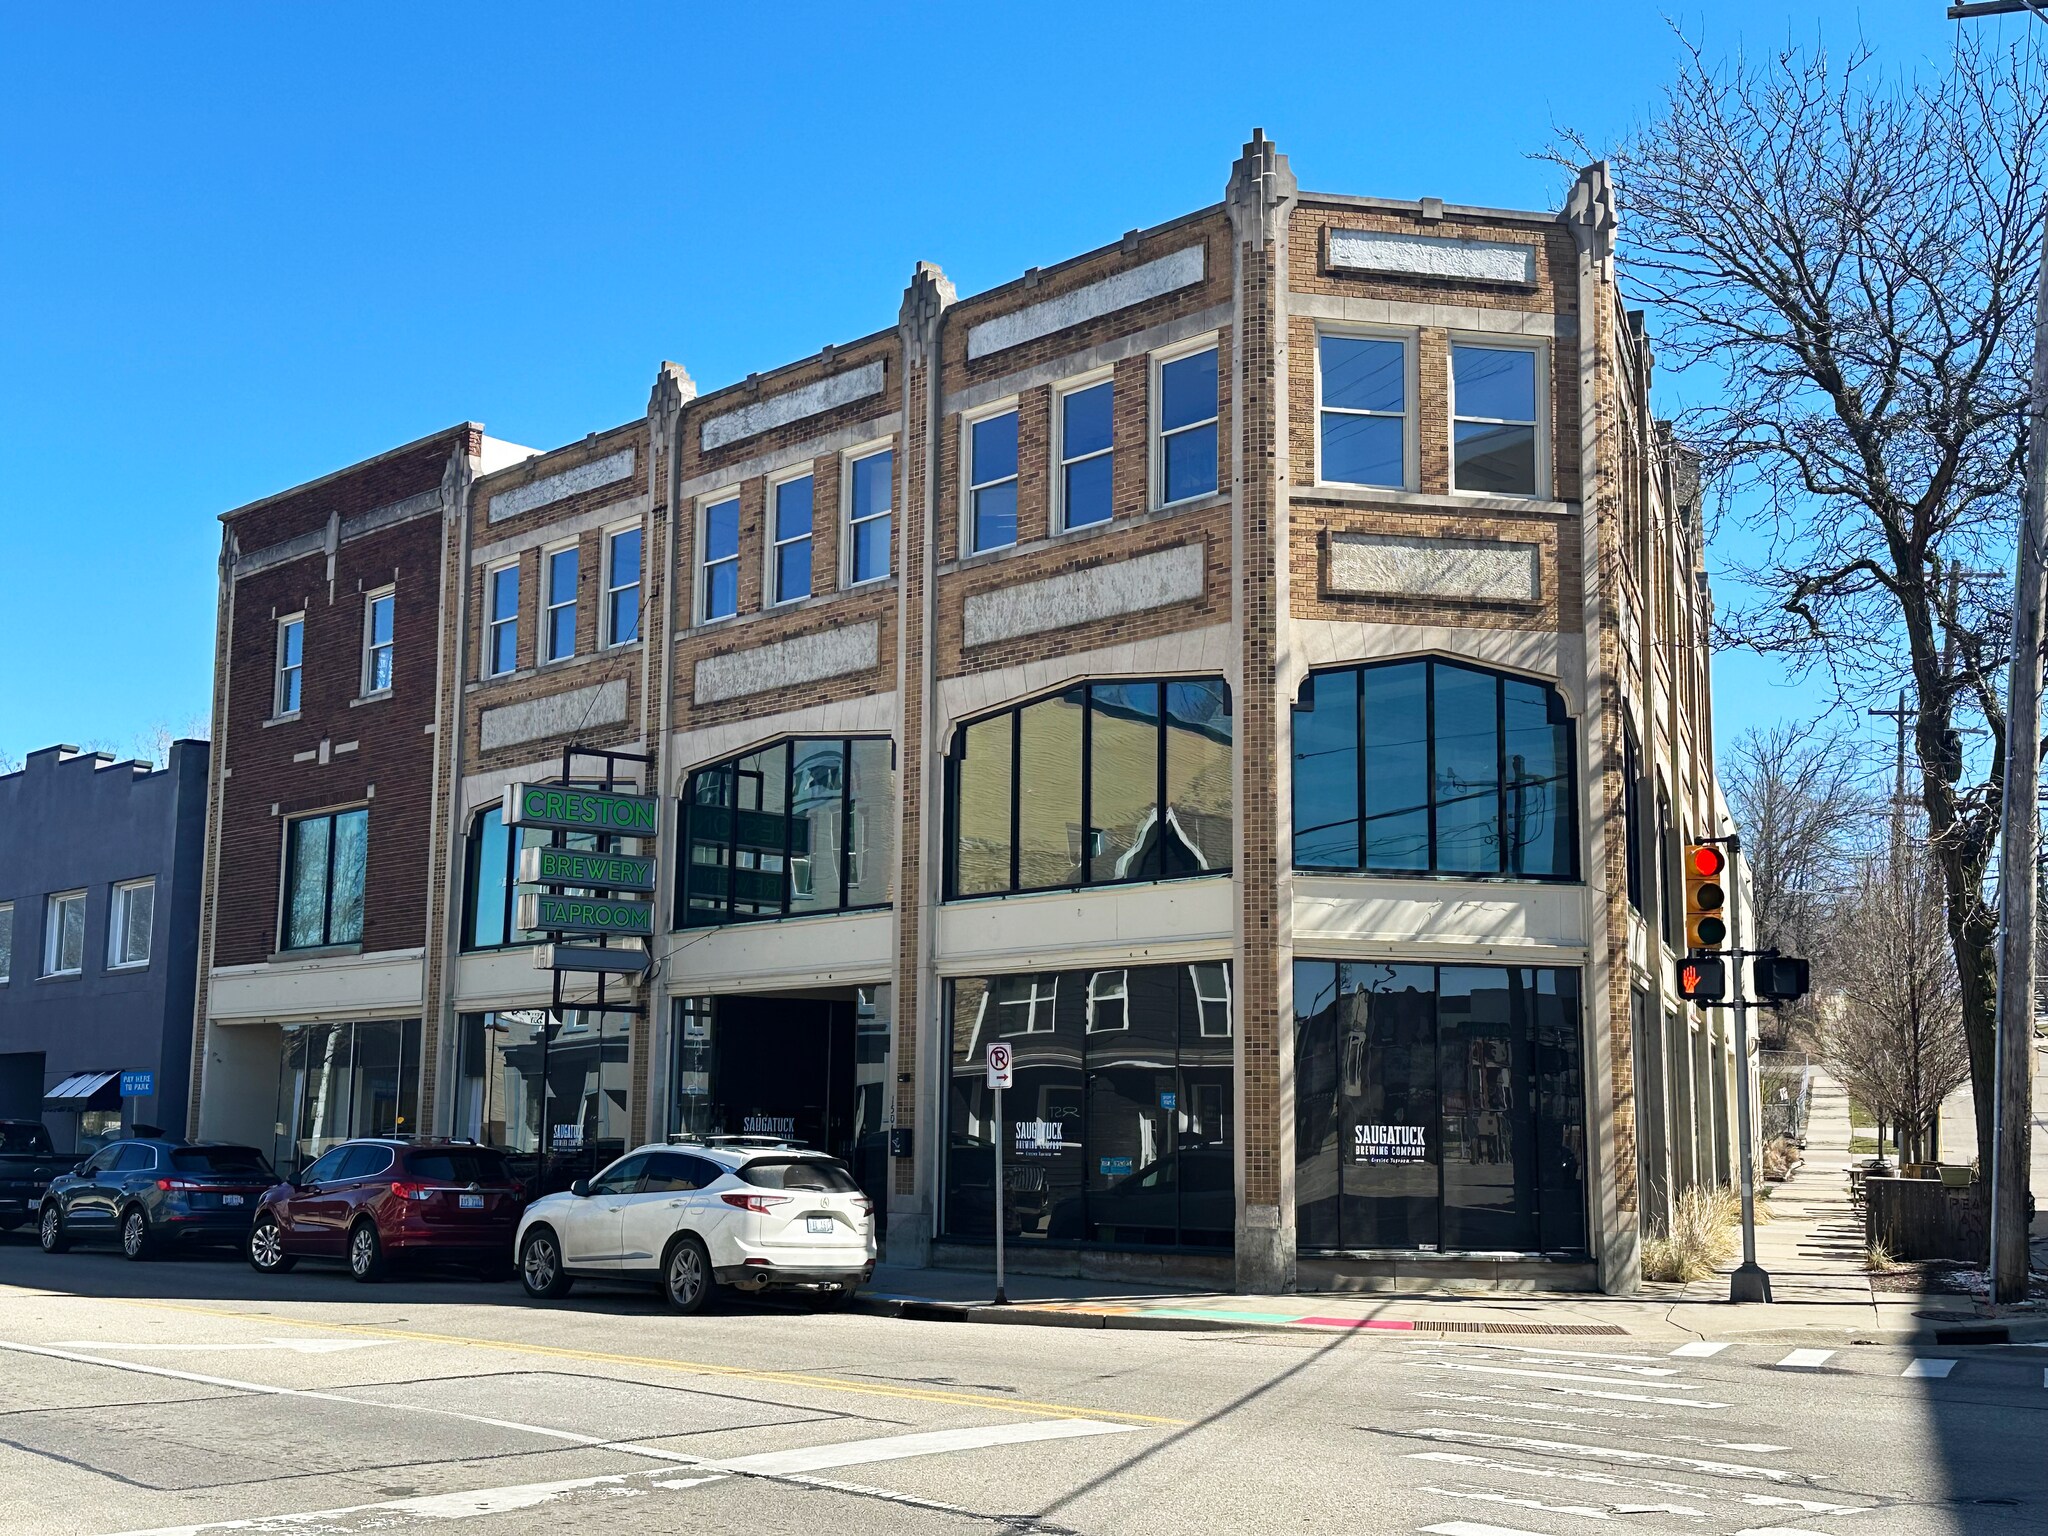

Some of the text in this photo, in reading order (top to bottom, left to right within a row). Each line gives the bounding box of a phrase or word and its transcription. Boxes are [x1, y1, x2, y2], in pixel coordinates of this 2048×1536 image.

[524, 791, 655, 829] CRESTON
[542, 853, 649, 884] BREWERY
[542, 902, 649, 928] TAPROOM
[123, 1075, 151, 1083] PAY HERE
[125, 1083, 132, 1091] TO
[743, 1117, 795, 1132] SAUGATUCK
[1355, 1125, 1426, 1146] SAUGATUCK
[1355, 1145, 1426, 1157] BREWING COMPANY
